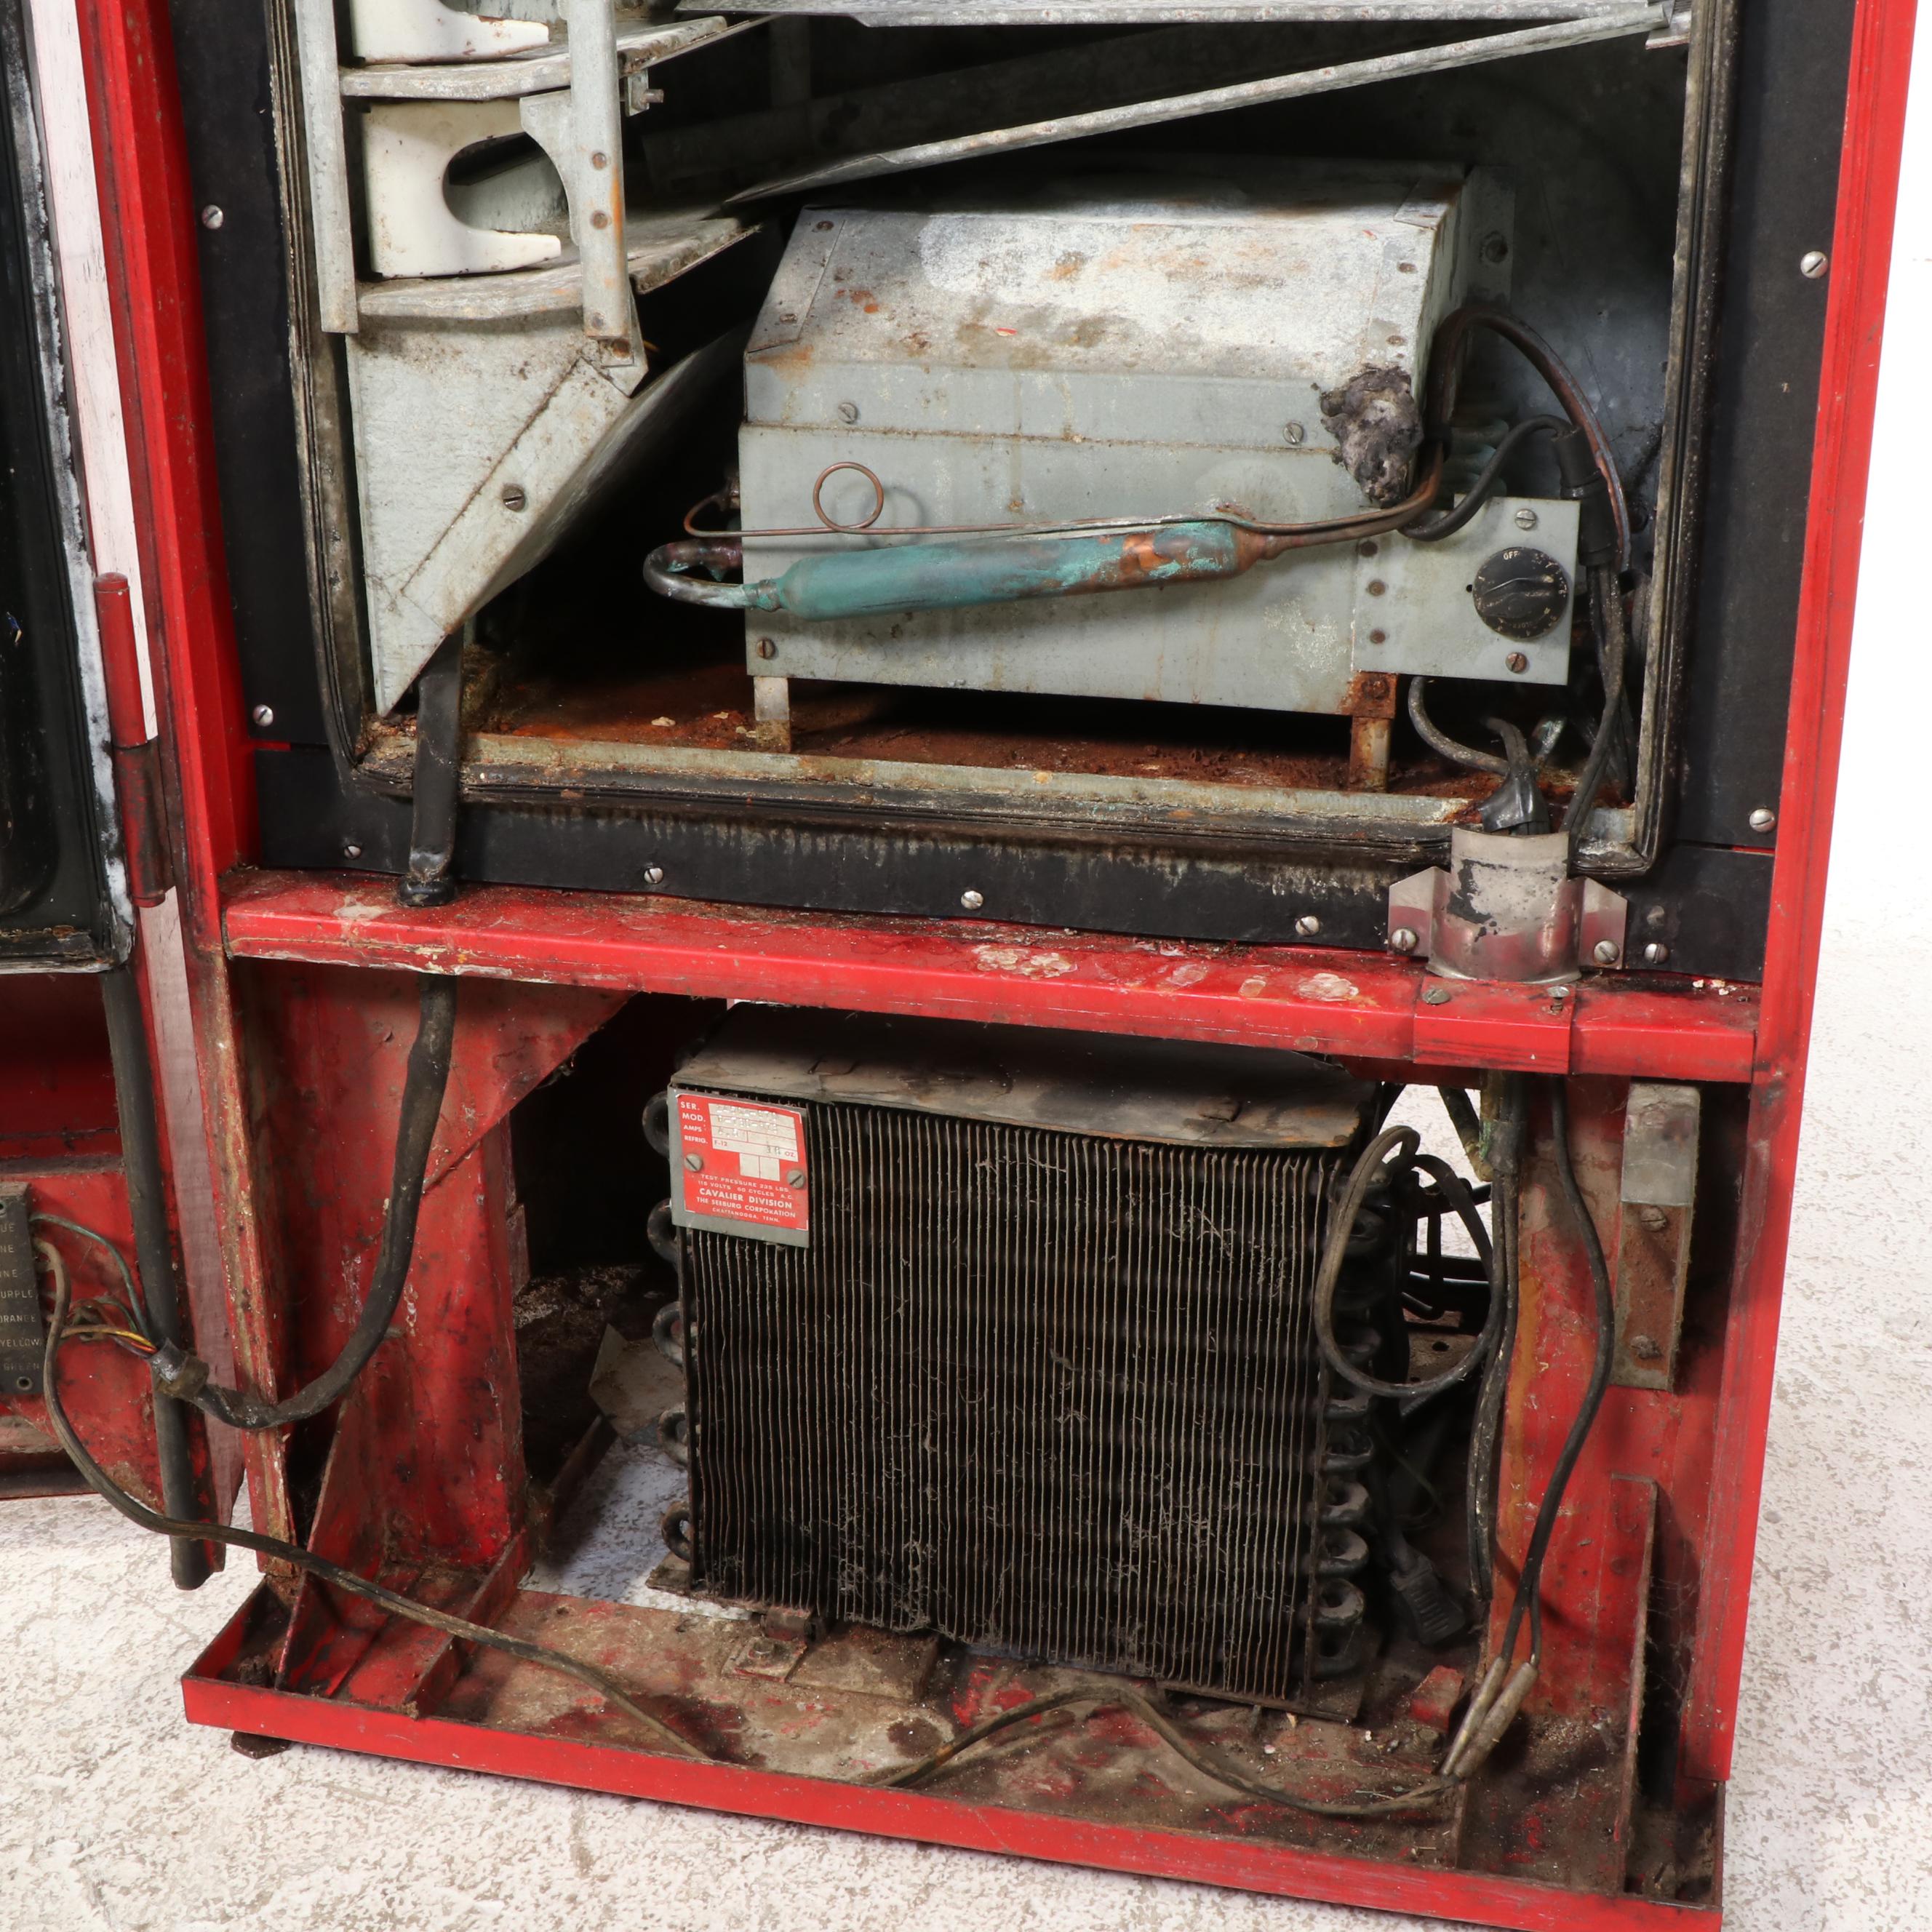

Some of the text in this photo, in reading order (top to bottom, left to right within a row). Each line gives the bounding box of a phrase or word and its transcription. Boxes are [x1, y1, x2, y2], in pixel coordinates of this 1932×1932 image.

[1503, 551, 1520, 560] OFF
[681, 1101, 700, 1111] SER.
[682, 1113, 706, 1122] MOD.
[684, 1135, 708, 1144] REFRIG.
[721, 1177, 757, 1188] PRESSURE
[710, 1182, 731, 1190] VOLTS
[749, 1189, 775, 1197] CYCLES
[699, 1188, 793, 1209] CAVALIER DIVISION
[711, 1199, 742, 1209] SEEBURG
[745, 1205, 797, 1218] CORPORATION
[0, 1339, 40, 1348] YELLOW
